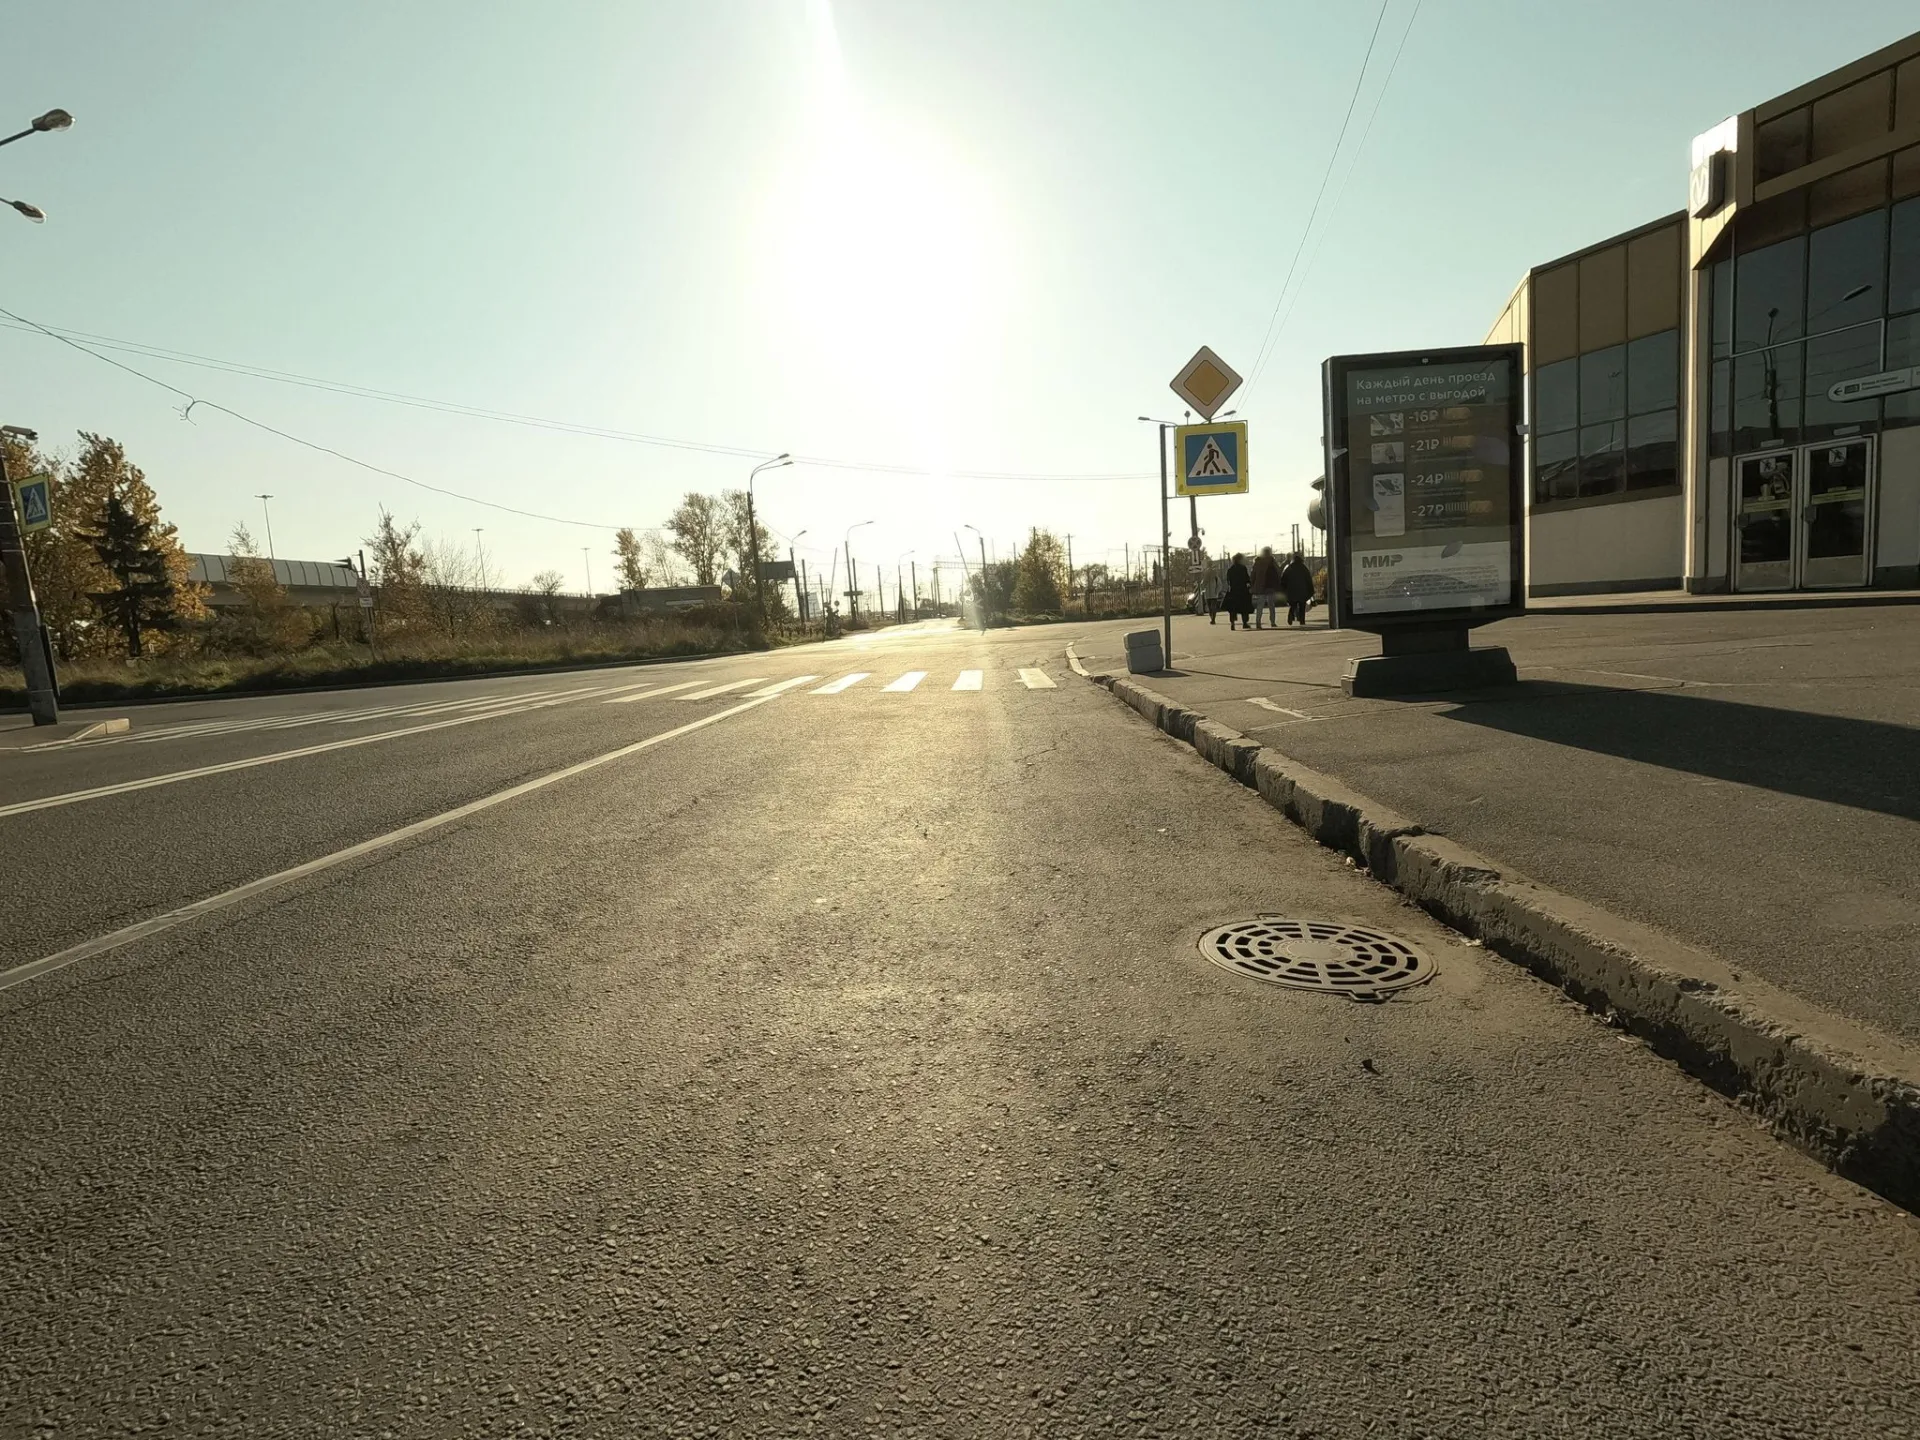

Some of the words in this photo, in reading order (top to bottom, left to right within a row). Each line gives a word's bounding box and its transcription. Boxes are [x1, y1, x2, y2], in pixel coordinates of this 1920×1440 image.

[1356, 376, 1410, 390] Каждый
[1414, 375, 1445, 387] день
[1448, 372, 1496, 386] проезд
[1356, 395, 1372, 405] на
[1376, 393, 1416, 405] метро
[1419, 392, 1426, 400] с
[1429, 386, 1486, 401] выгодой
[1361, 553, 1403, 569] МИР
